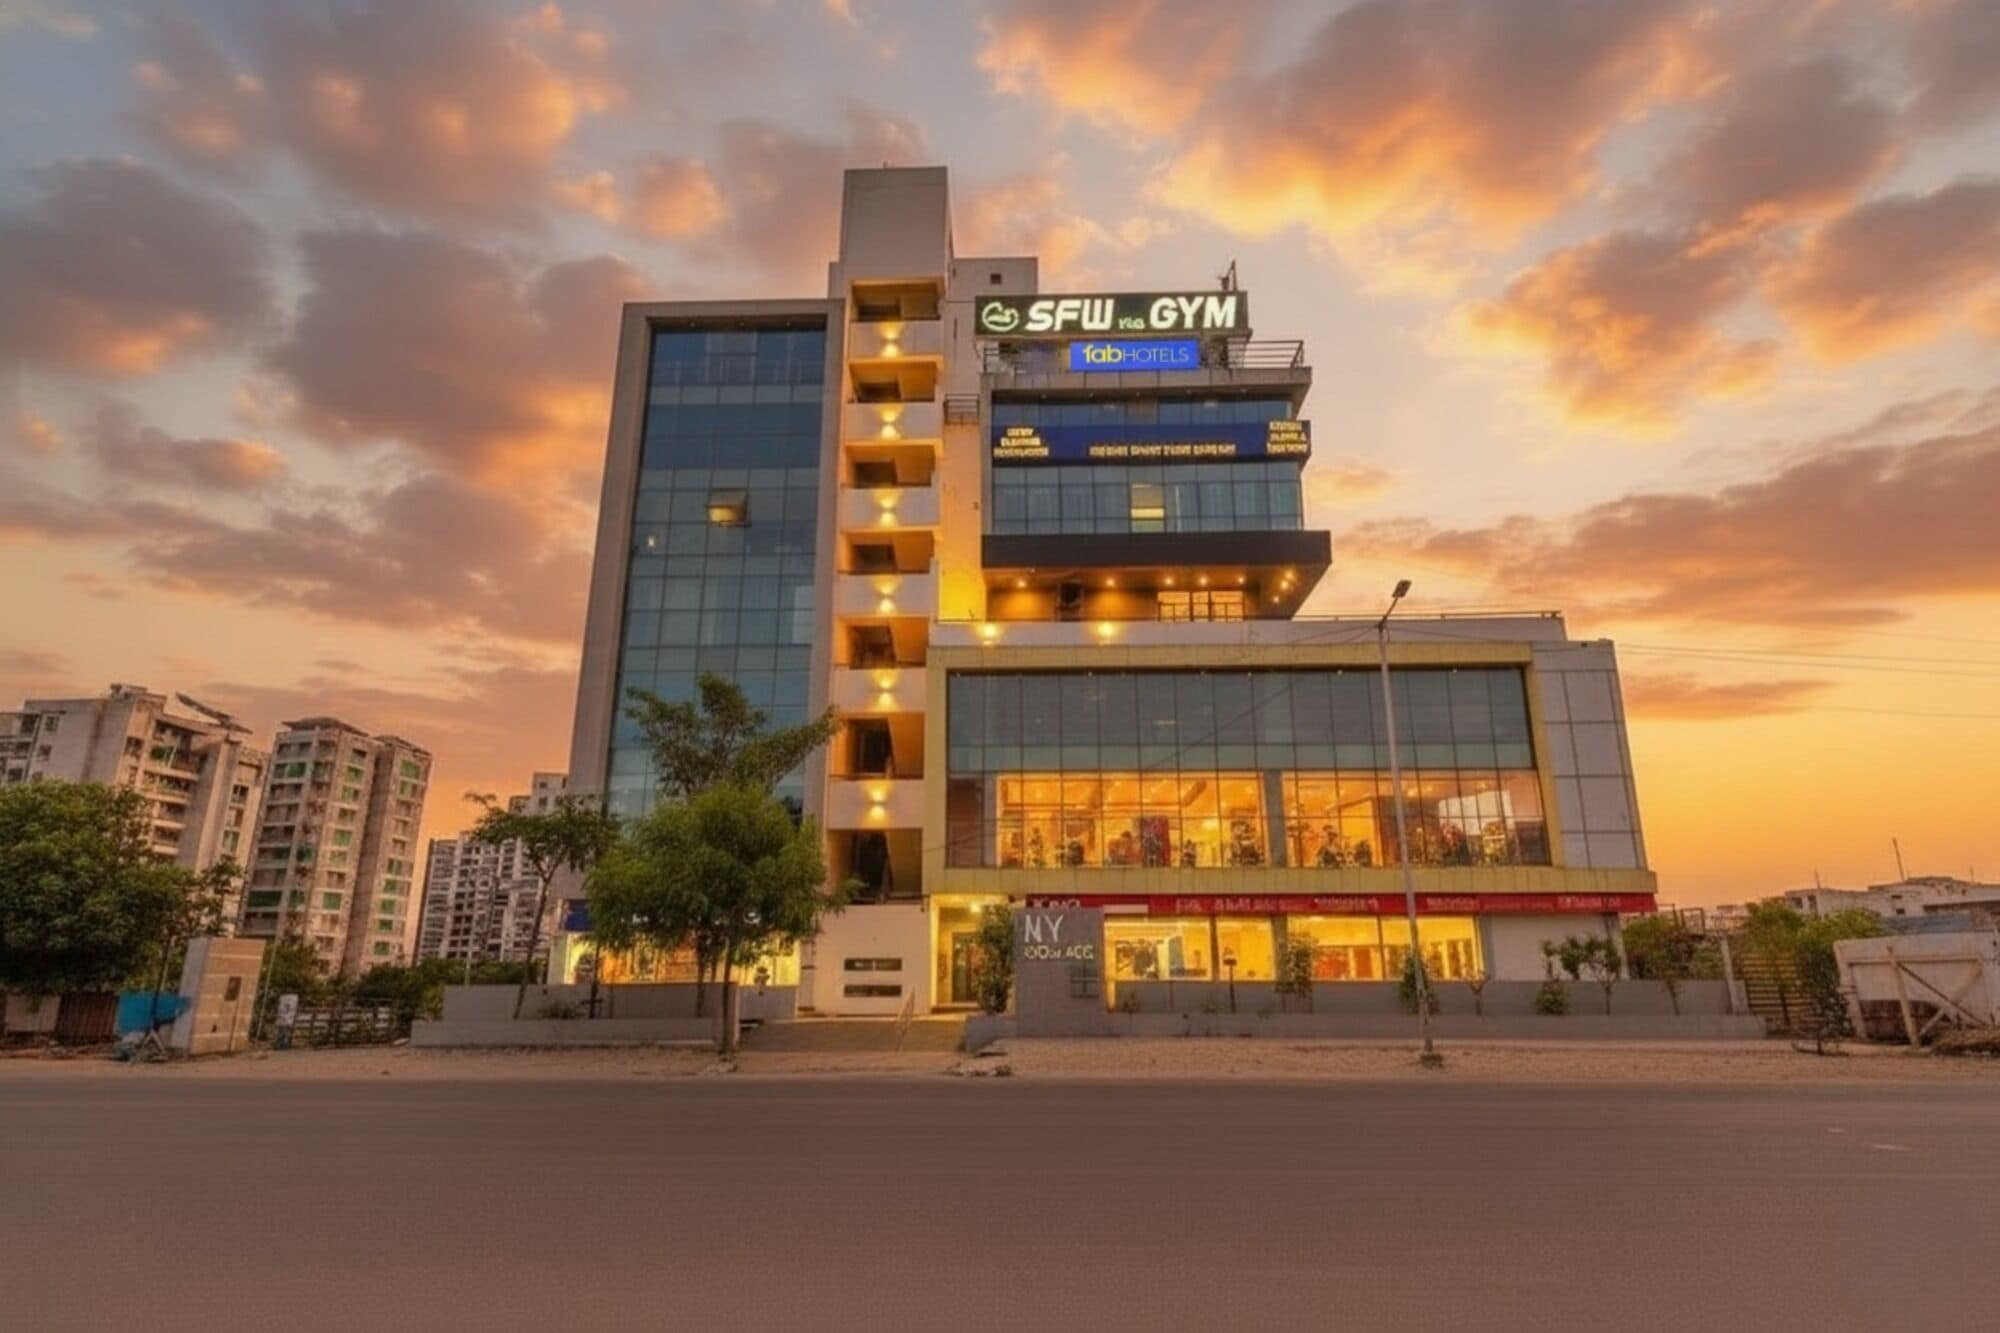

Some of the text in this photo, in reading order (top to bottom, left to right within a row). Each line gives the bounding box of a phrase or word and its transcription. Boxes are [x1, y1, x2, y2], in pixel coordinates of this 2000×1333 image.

[1024, 295, 1238, 331] SFW GYM
[1082, 344, 1190, 364] fabHOTELS
